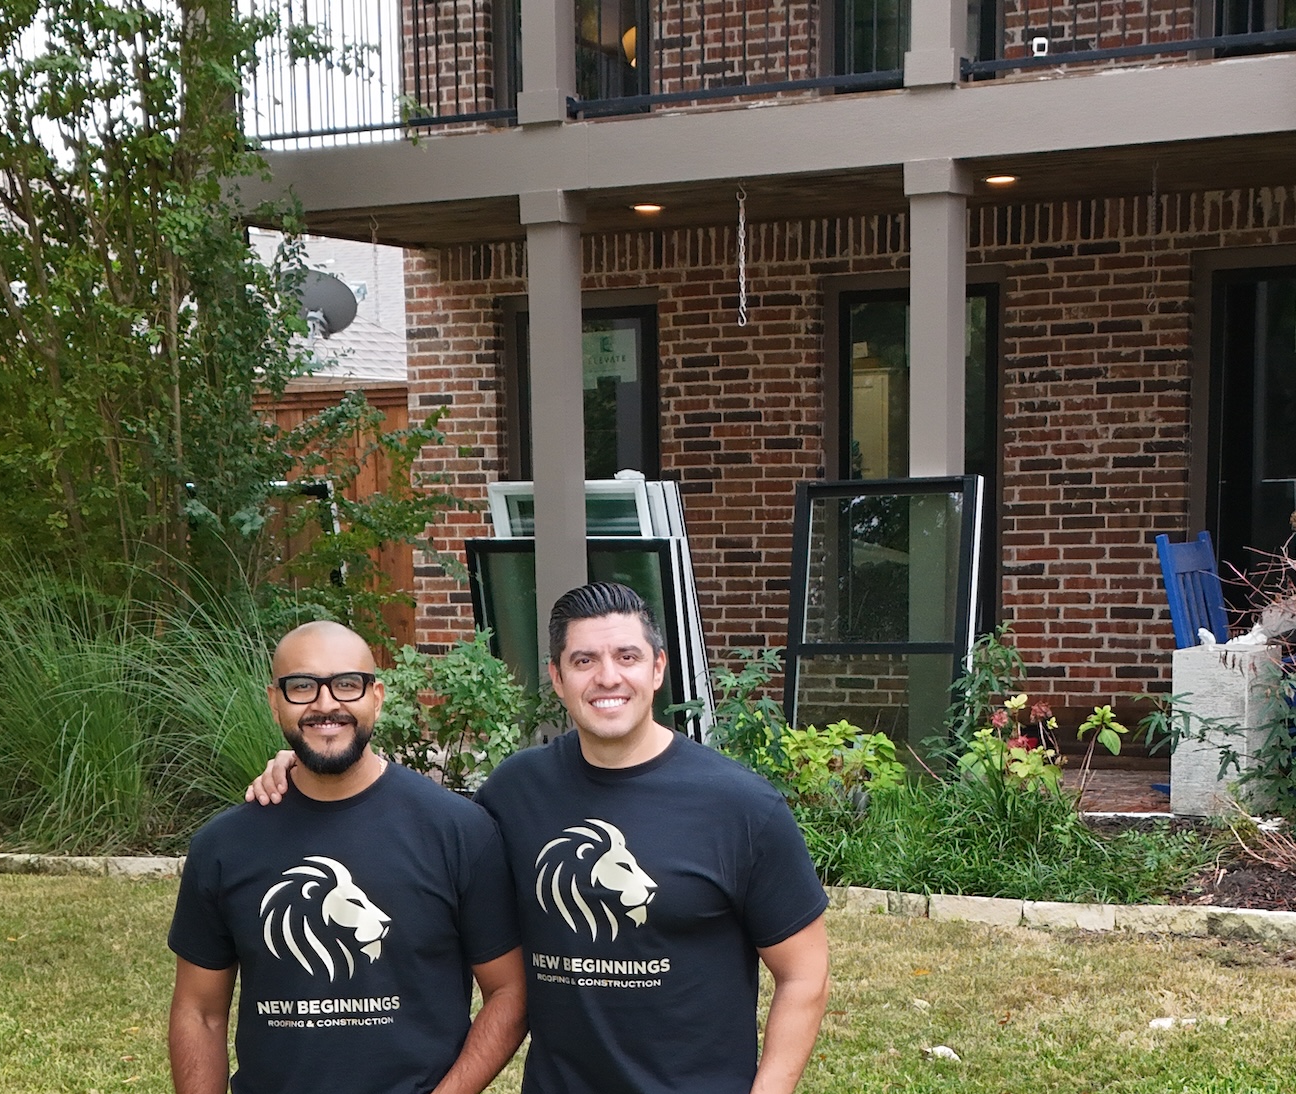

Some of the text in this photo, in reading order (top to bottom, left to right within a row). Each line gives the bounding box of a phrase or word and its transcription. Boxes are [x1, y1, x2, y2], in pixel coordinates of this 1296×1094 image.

[532, 953, 671, 975] NEW BEGINNINGS
[537, 973, 570, 985] ROOFING
[577, 978, 662, 988] CONSTRUCTION
[256, 996, 400, 1015] NEW BEGINNINGS
[268, 1016, 394, 1028] ROOFING & CONSTRUCTION
